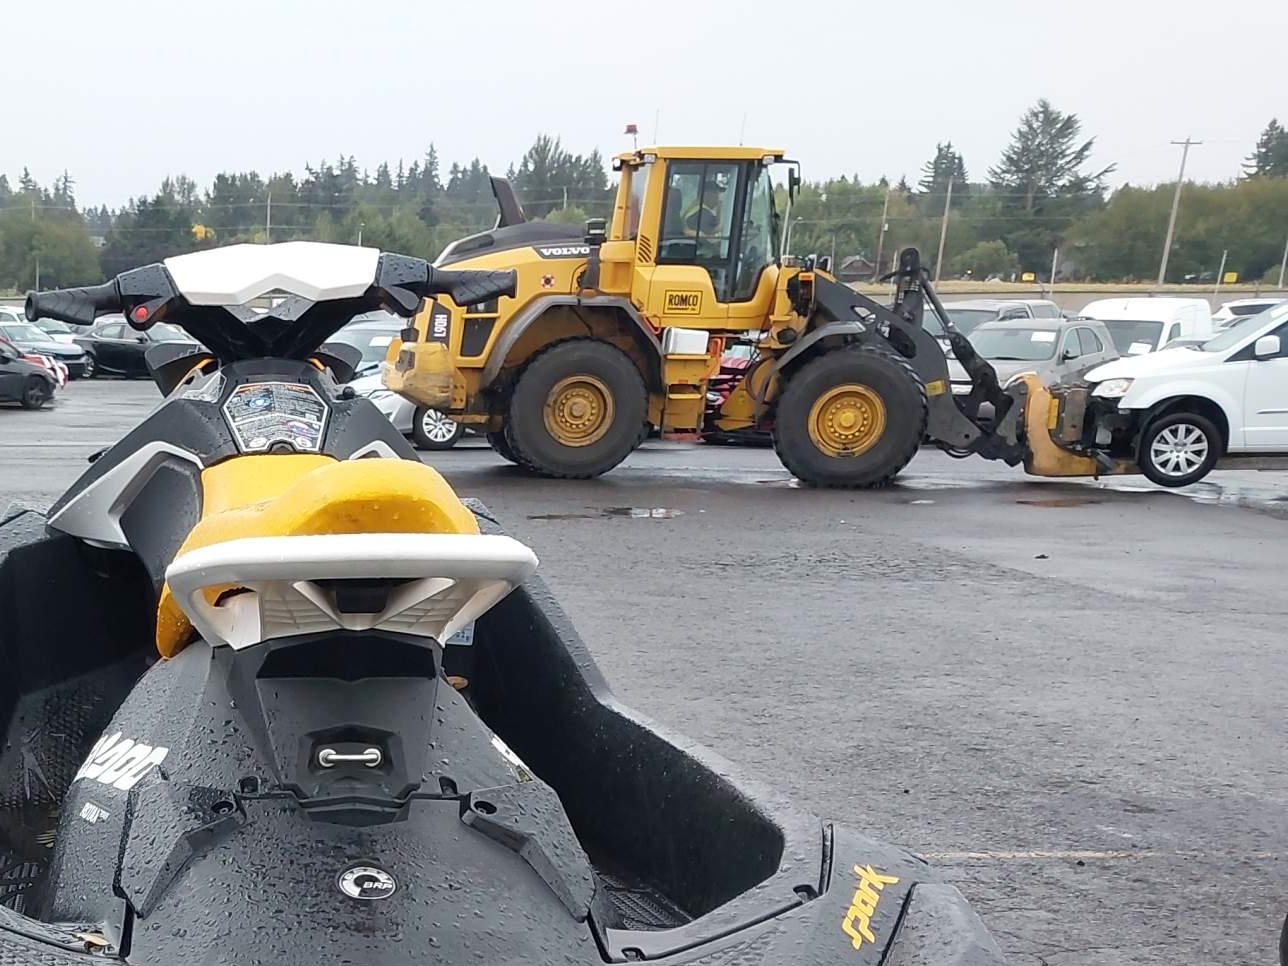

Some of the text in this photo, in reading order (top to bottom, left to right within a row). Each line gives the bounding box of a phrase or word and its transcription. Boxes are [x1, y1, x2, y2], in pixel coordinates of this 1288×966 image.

[540, 247, 590, 256] VOLVO
[668, 294, 699, 307] ROMCO
[433, 314, 448, 337] L90H
[363, 881, 393, 890] BRP
